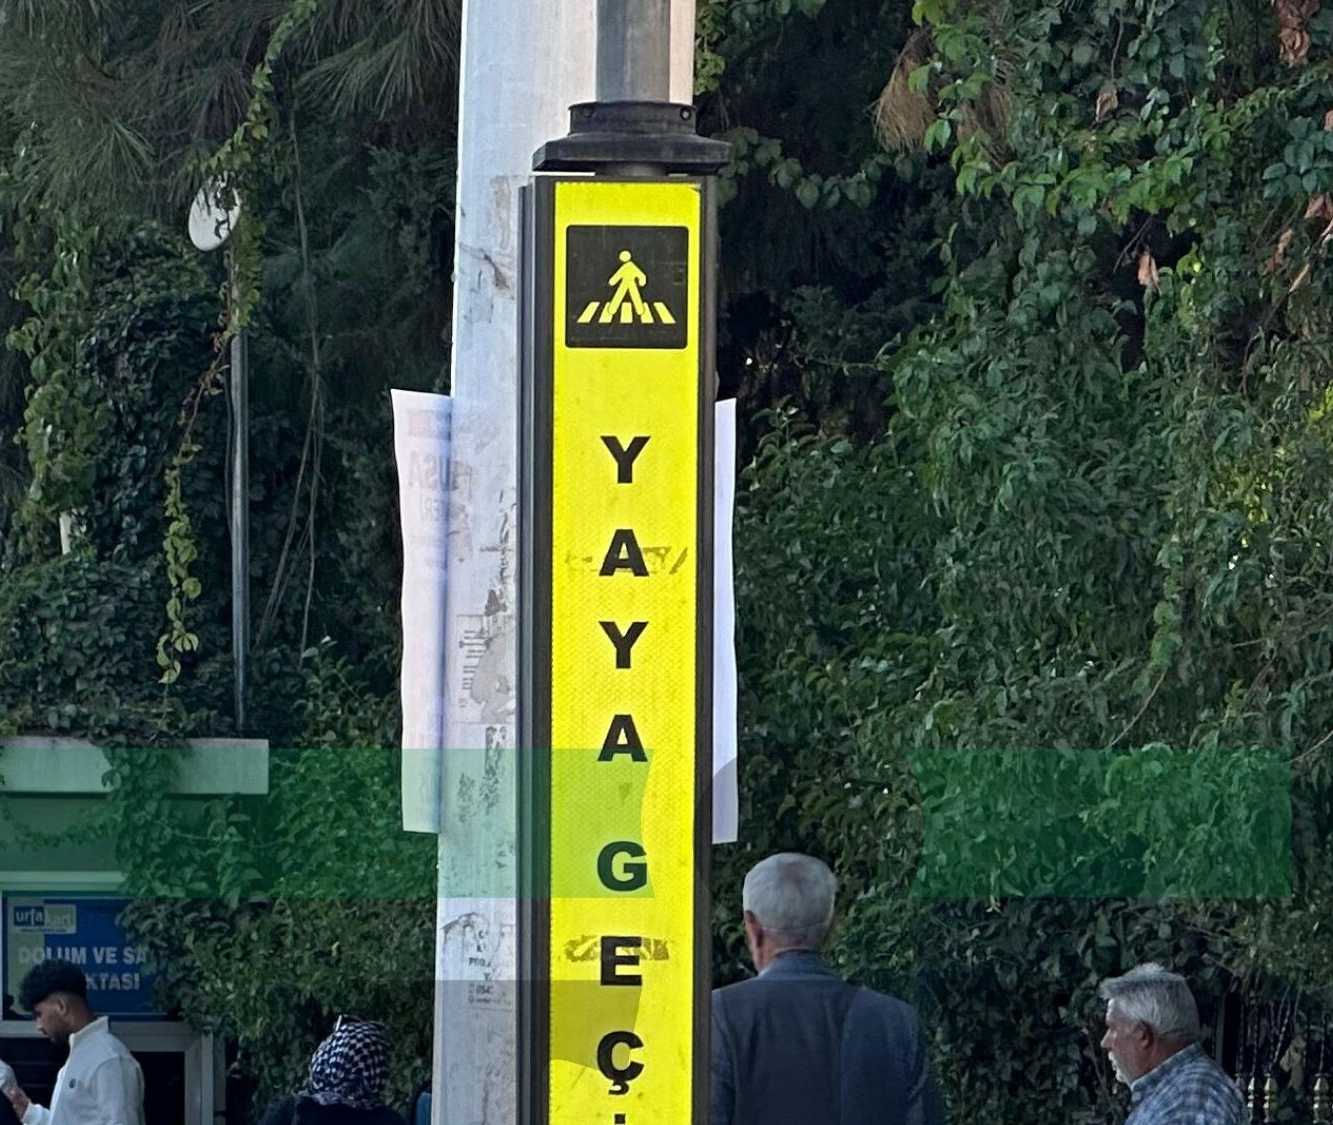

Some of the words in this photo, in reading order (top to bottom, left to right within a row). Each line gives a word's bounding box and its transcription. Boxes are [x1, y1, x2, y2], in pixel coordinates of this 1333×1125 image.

[597, 435, 651, 763] YAYA
[92, 946, 117, 965] VE
[123, 947, 147, 965] SA
